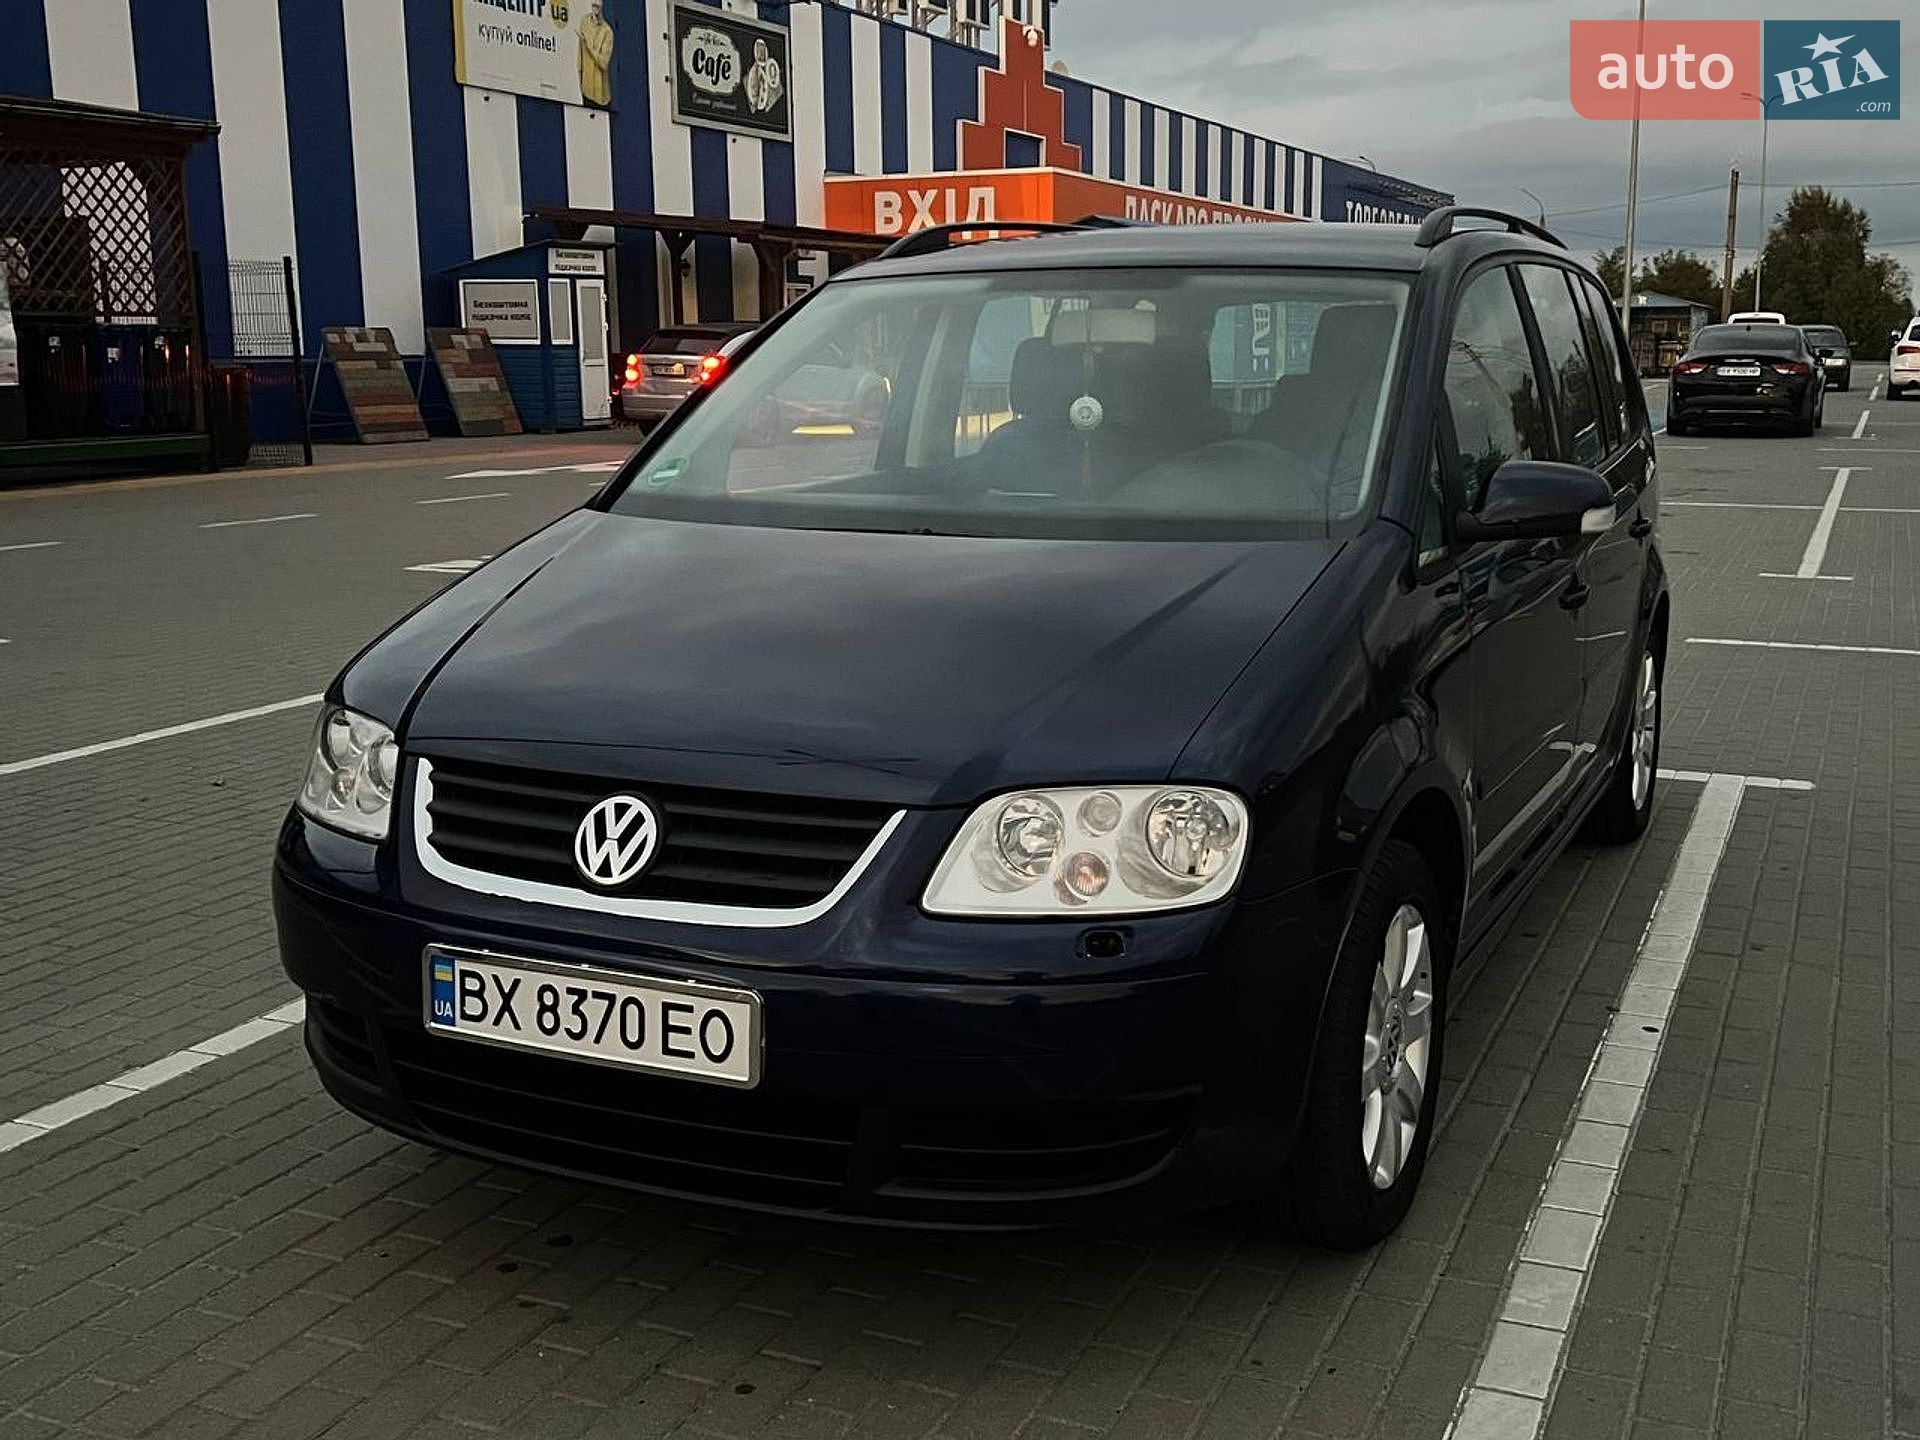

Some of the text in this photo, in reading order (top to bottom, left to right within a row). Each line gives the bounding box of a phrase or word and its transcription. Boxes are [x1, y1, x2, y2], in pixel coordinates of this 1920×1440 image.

[478, 23, 556, 52] купуй online!
[874, 186, 999, 240] ВХІД
[434, 999, 454, 1018] UA
[459, 968, 735, 1064] BX 8370 EO
